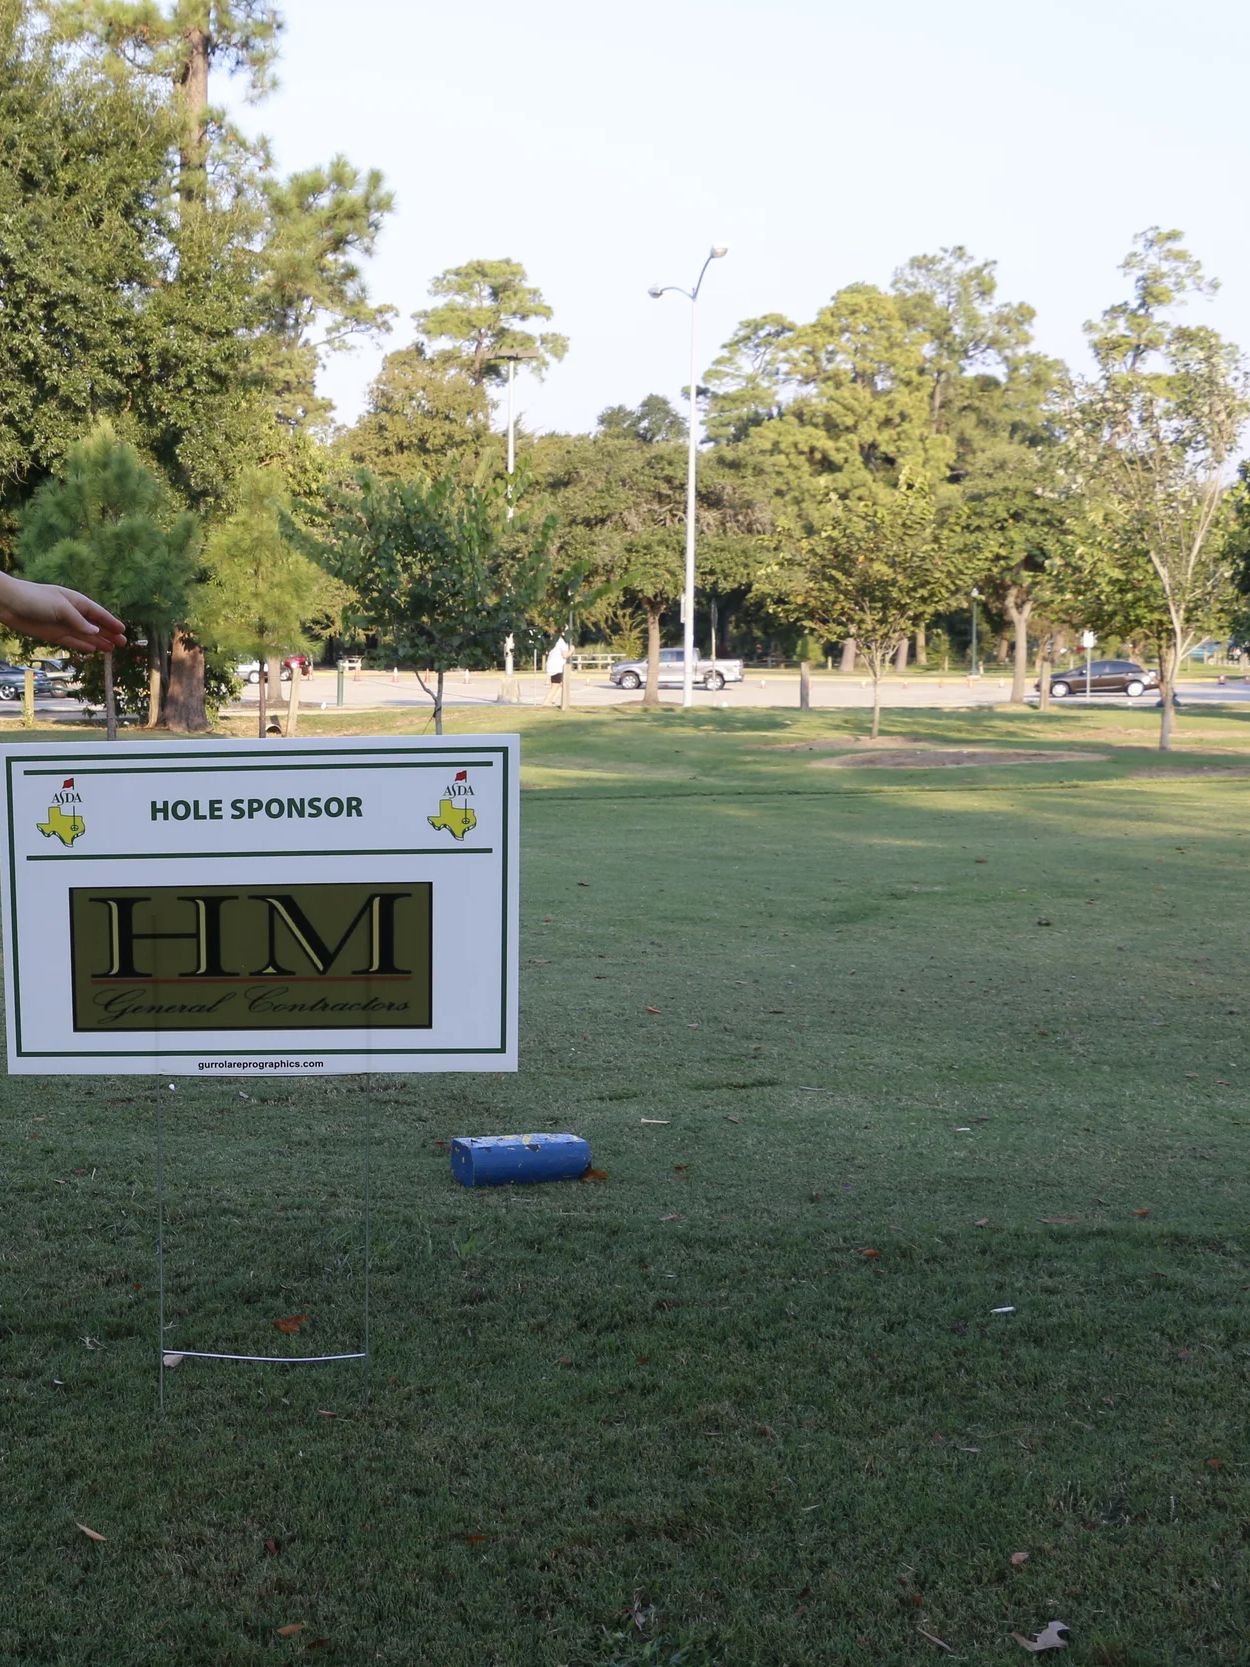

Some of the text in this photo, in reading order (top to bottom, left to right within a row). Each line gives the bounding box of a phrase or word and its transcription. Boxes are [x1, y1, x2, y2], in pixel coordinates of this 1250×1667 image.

[51, 790, 82, 806] ASDA
[443, 783, 474, 798] ASDA
[151, 797, 363, 821] HOLE SPONSOR
[89, 893, 413, 978] HM
[92, 985, 411, 1024] General Contractors
[198, 1060, 324, 1071] gurrolareprographics.com
